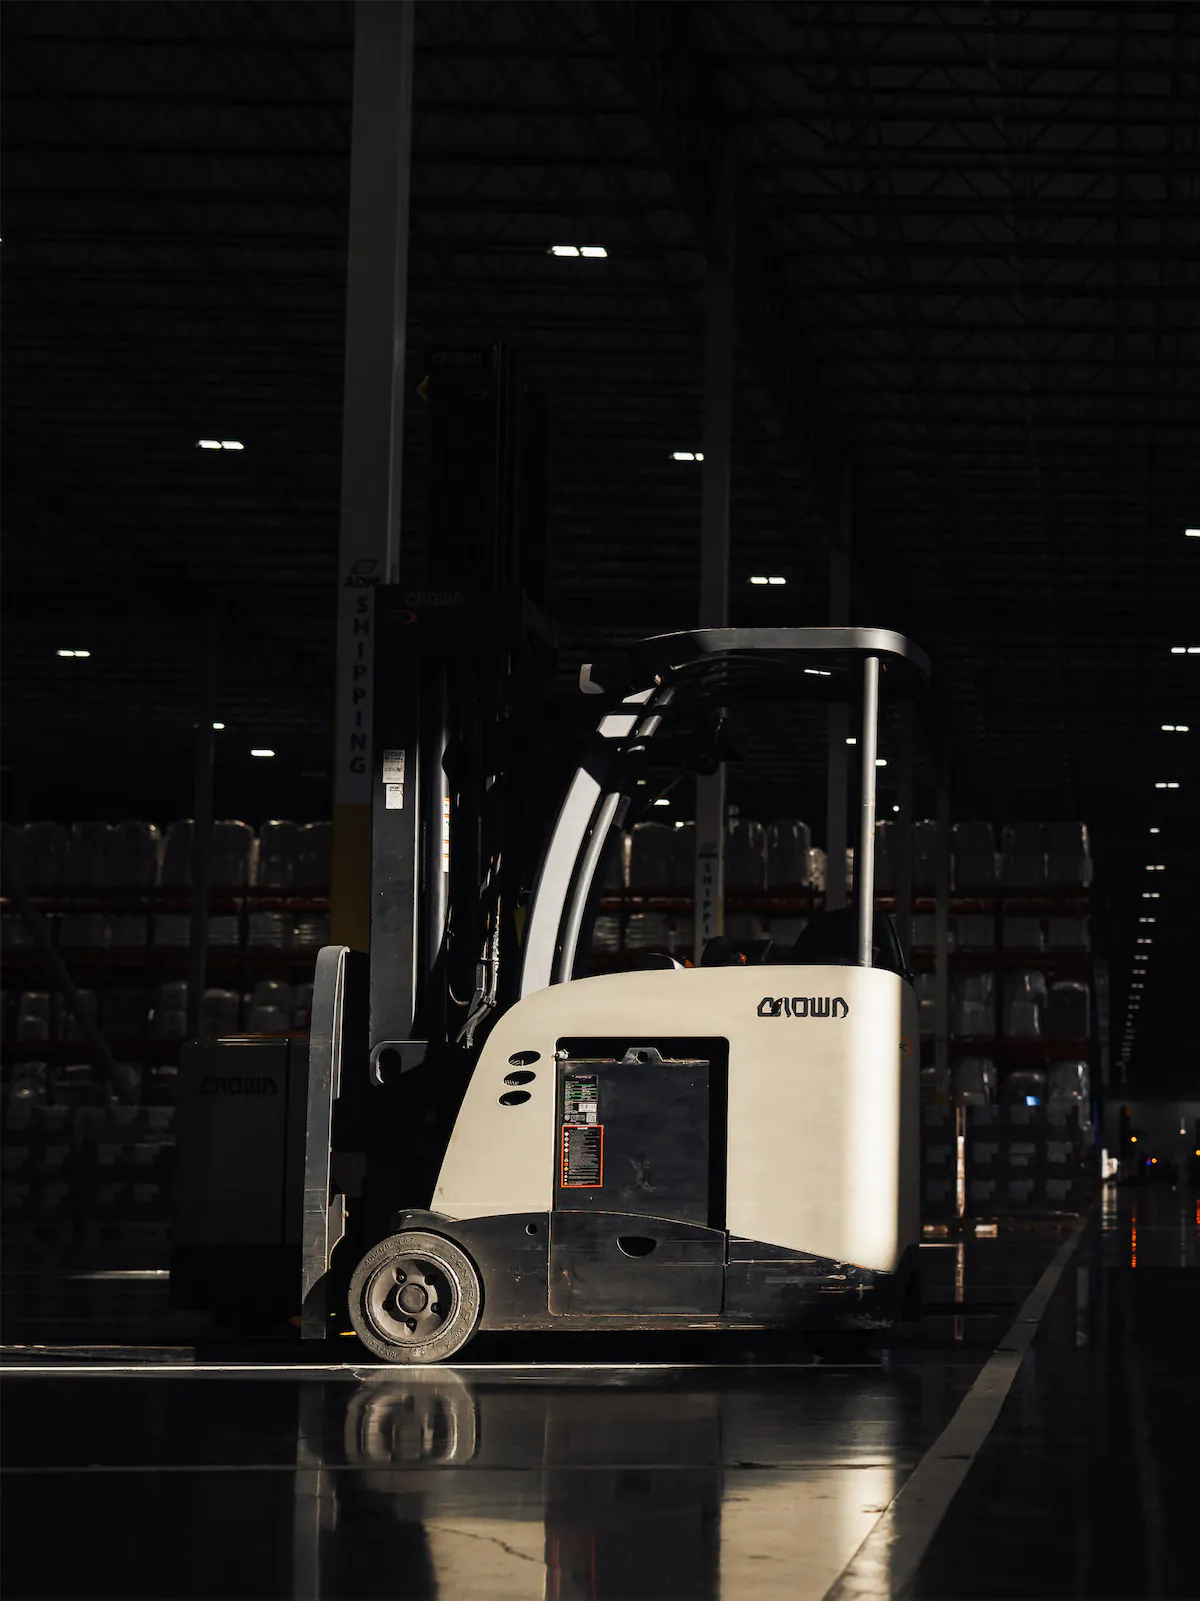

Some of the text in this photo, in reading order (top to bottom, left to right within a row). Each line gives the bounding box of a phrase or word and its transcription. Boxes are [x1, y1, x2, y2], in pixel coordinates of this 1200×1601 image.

[345, 577, 380, 588] ADM
[350, 596, 369, 774] SHIPPING
[757, 997, 849, 1018] CROWN
[201, 1077, 278, 1095] CROWN
